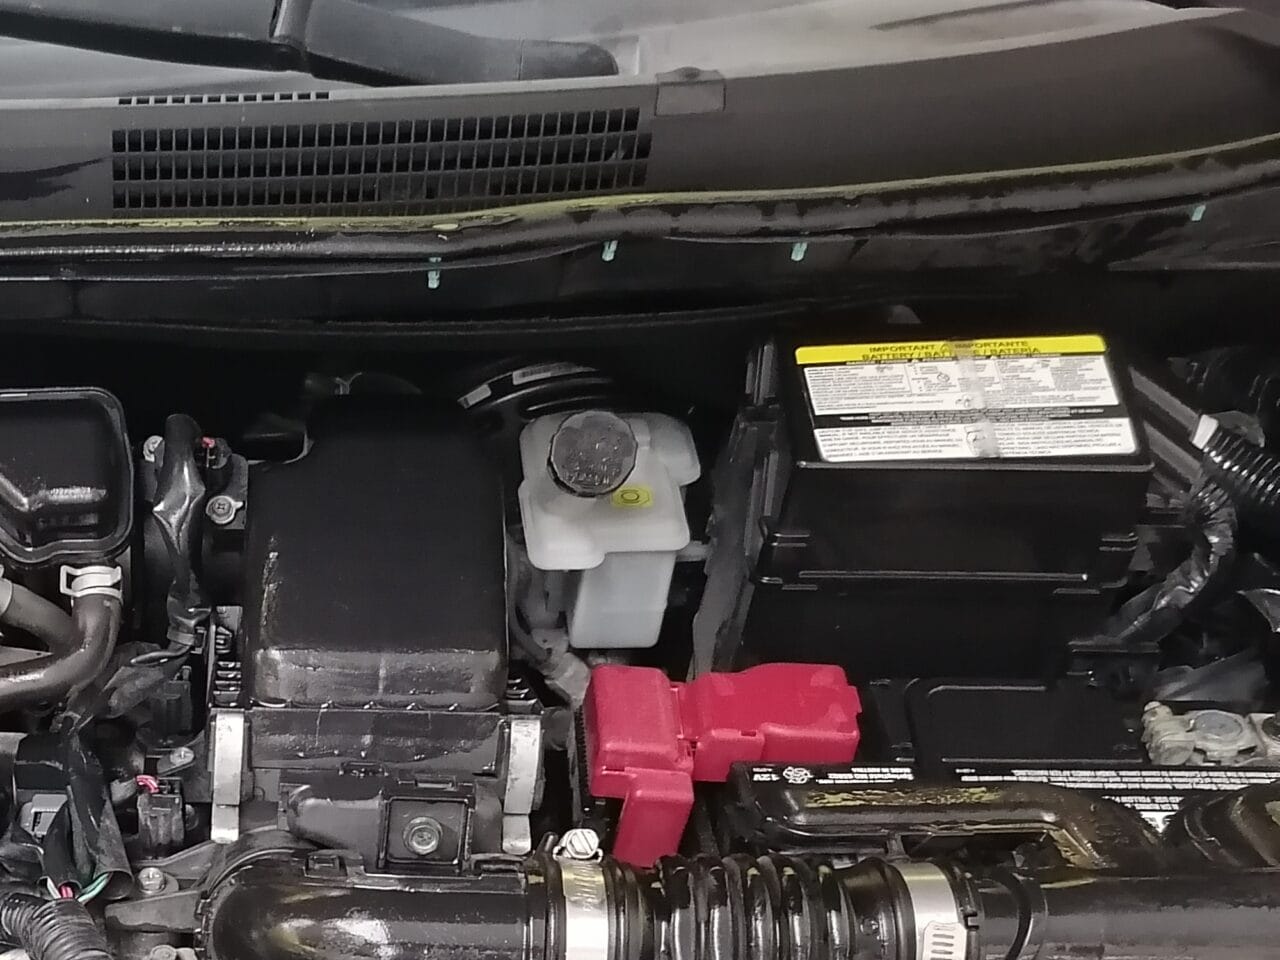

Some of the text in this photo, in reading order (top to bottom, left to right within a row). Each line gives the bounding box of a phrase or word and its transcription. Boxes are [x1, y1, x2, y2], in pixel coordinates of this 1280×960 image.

[868, 340, 1029, 353] IMPORTANT IMPORTANTE
[862, 351, 916, 361] BATTERY
